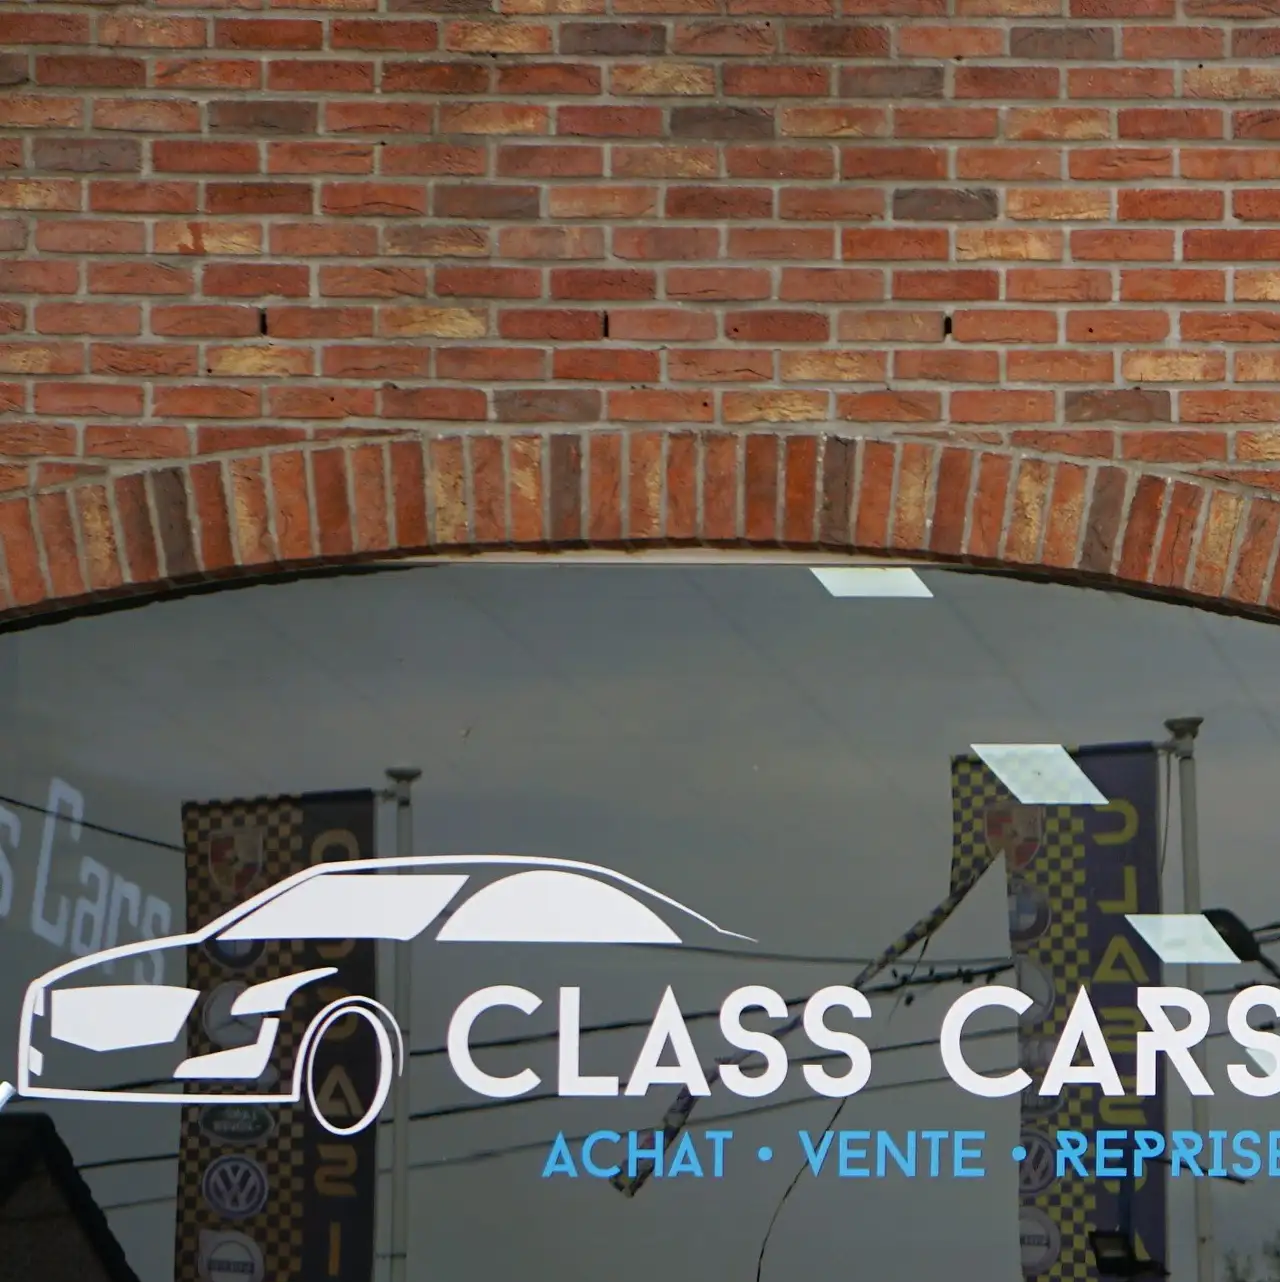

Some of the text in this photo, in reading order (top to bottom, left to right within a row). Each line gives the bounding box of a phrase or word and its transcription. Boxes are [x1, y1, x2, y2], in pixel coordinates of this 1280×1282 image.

[447, 985, 872, 1098] CLASS
[541, 1130, 733, 1178] ACHAT
[797, 1130, 986, 1178] VENTE
